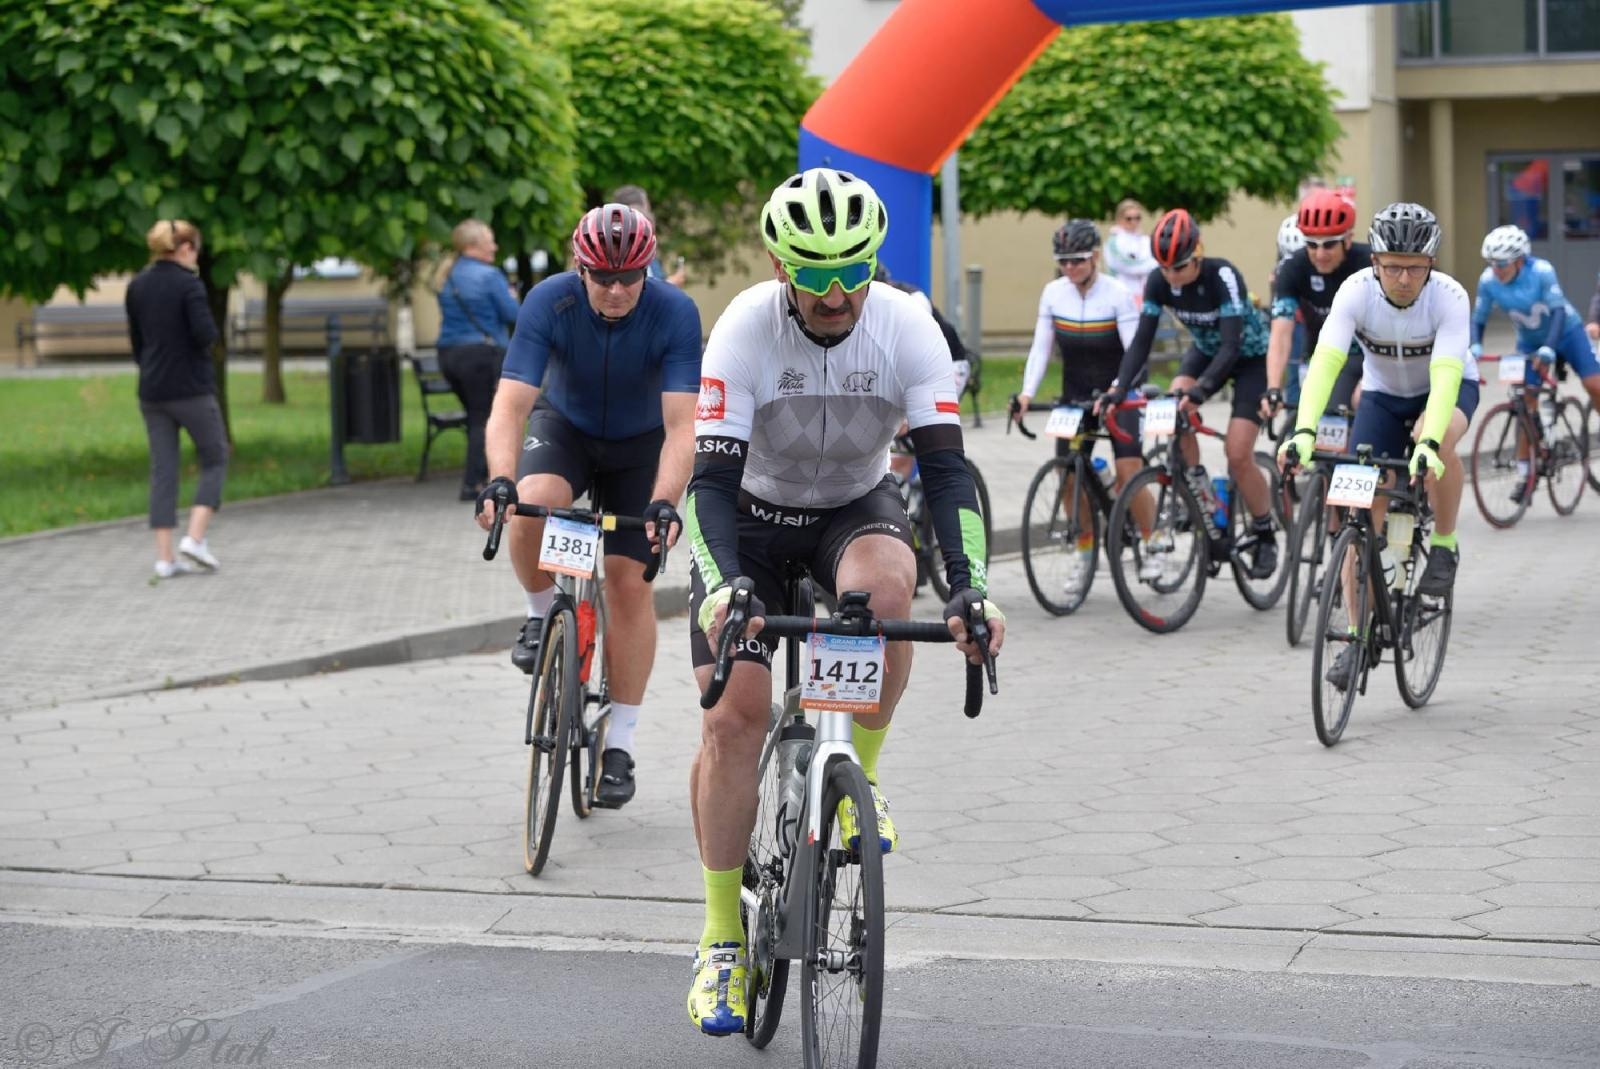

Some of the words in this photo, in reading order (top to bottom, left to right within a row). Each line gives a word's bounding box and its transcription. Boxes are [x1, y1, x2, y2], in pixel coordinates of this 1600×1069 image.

[694, 439, 742, 458] LSKA
[1334, 477, 1373, 492] 2250
[547, 534, 593, 558] 1381
[809, 658, 879, 683] 1412
